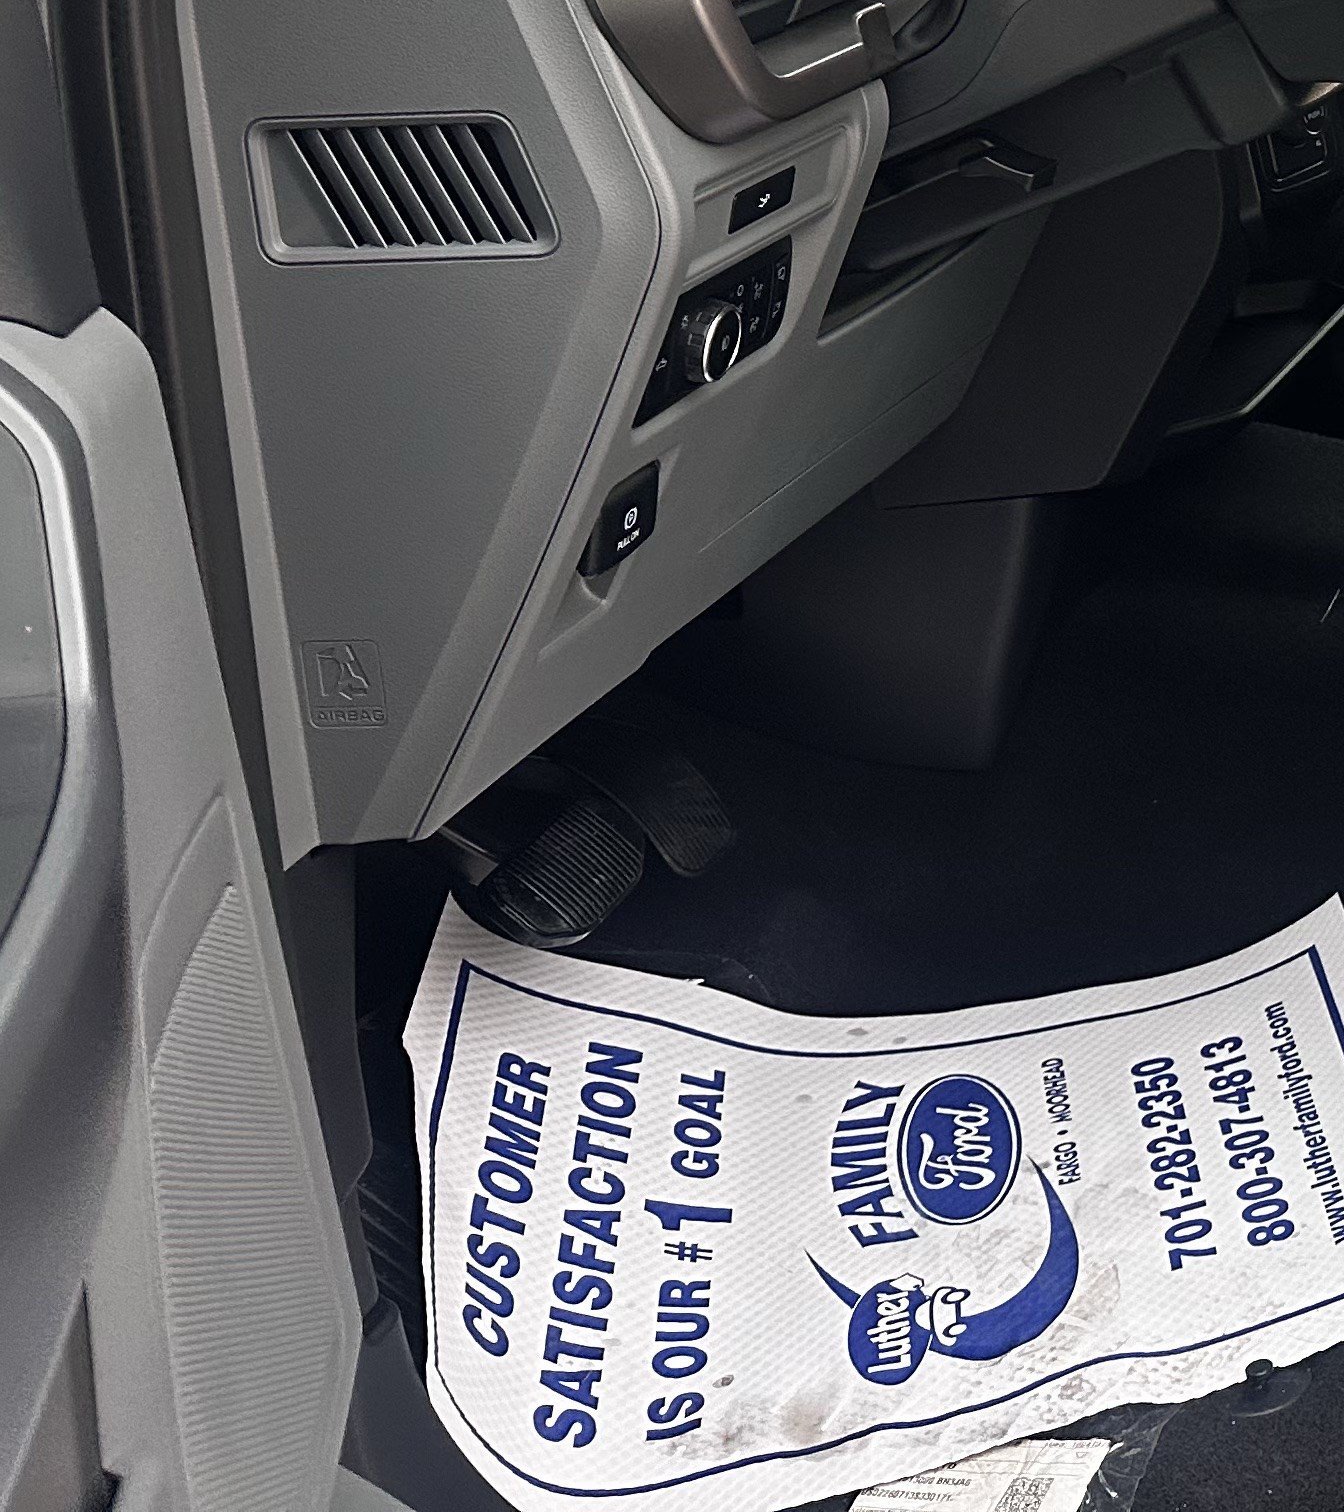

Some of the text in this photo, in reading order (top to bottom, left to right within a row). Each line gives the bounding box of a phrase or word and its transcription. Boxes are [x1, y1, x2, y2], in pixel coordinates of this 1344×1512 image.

[316, 710, 385, 723] AIRBAG
[461, 1050, 554, 1358] CUSTOMER
[831, 1080, 919, 1248] FAMILY
[918, 1102, 996, 1190] Ford
[1041, 1057, 1082, 1185] FARGO MOORHEAD
[1130, 1056, 1218, 1271] 701-282-2350
[1200, 1036, 1295, 1247] 800-307-4813
[531, 1039, 645, 1450] SATISFACTION
[643, 1069, 733, 1441] IS OUR #1 GOAL
[867, 1290, 913, 1374] Luther
